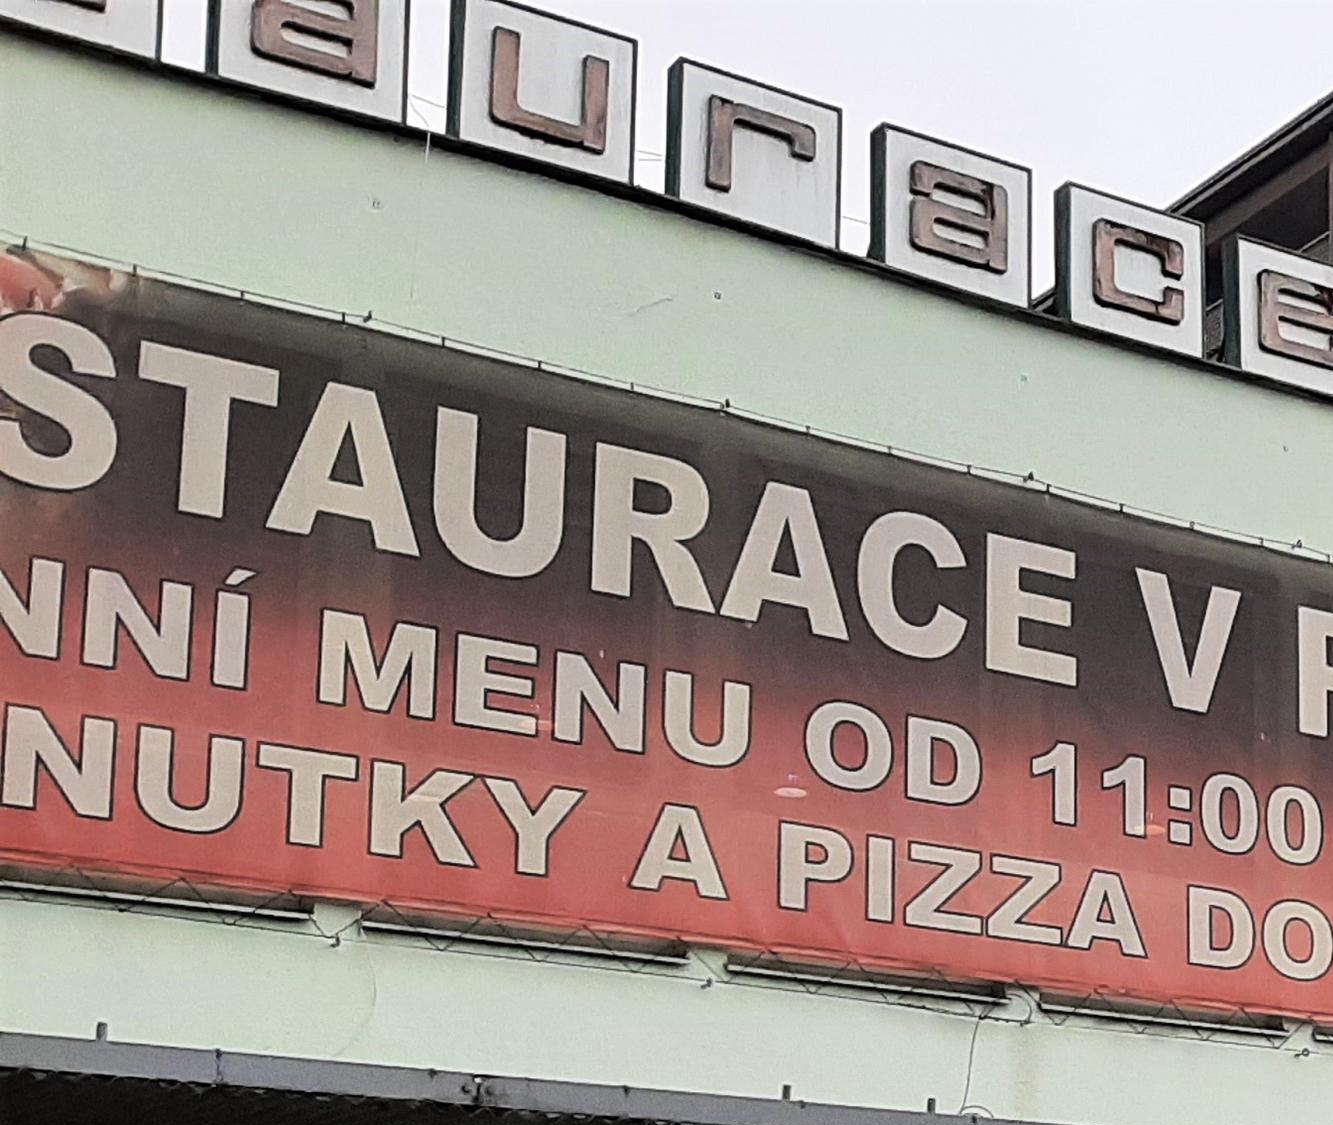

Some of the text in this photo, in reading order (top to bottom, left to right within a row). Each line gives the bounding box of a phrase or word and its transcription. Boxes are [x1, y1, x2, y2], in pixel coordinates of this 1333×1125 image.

[0, 313, 1077, 687] STAURACE
[1135, 567, 1241, 714] V
[2, 702, 588, 877] NUTKY
[629, 802, 729, 902] A
[777, 819, 1148, 959] PIZZA
[316, 608, 752, 767] MENU
[804, 699, 982, 806] OD
[1029, 741, 1323, 867] 11:00
